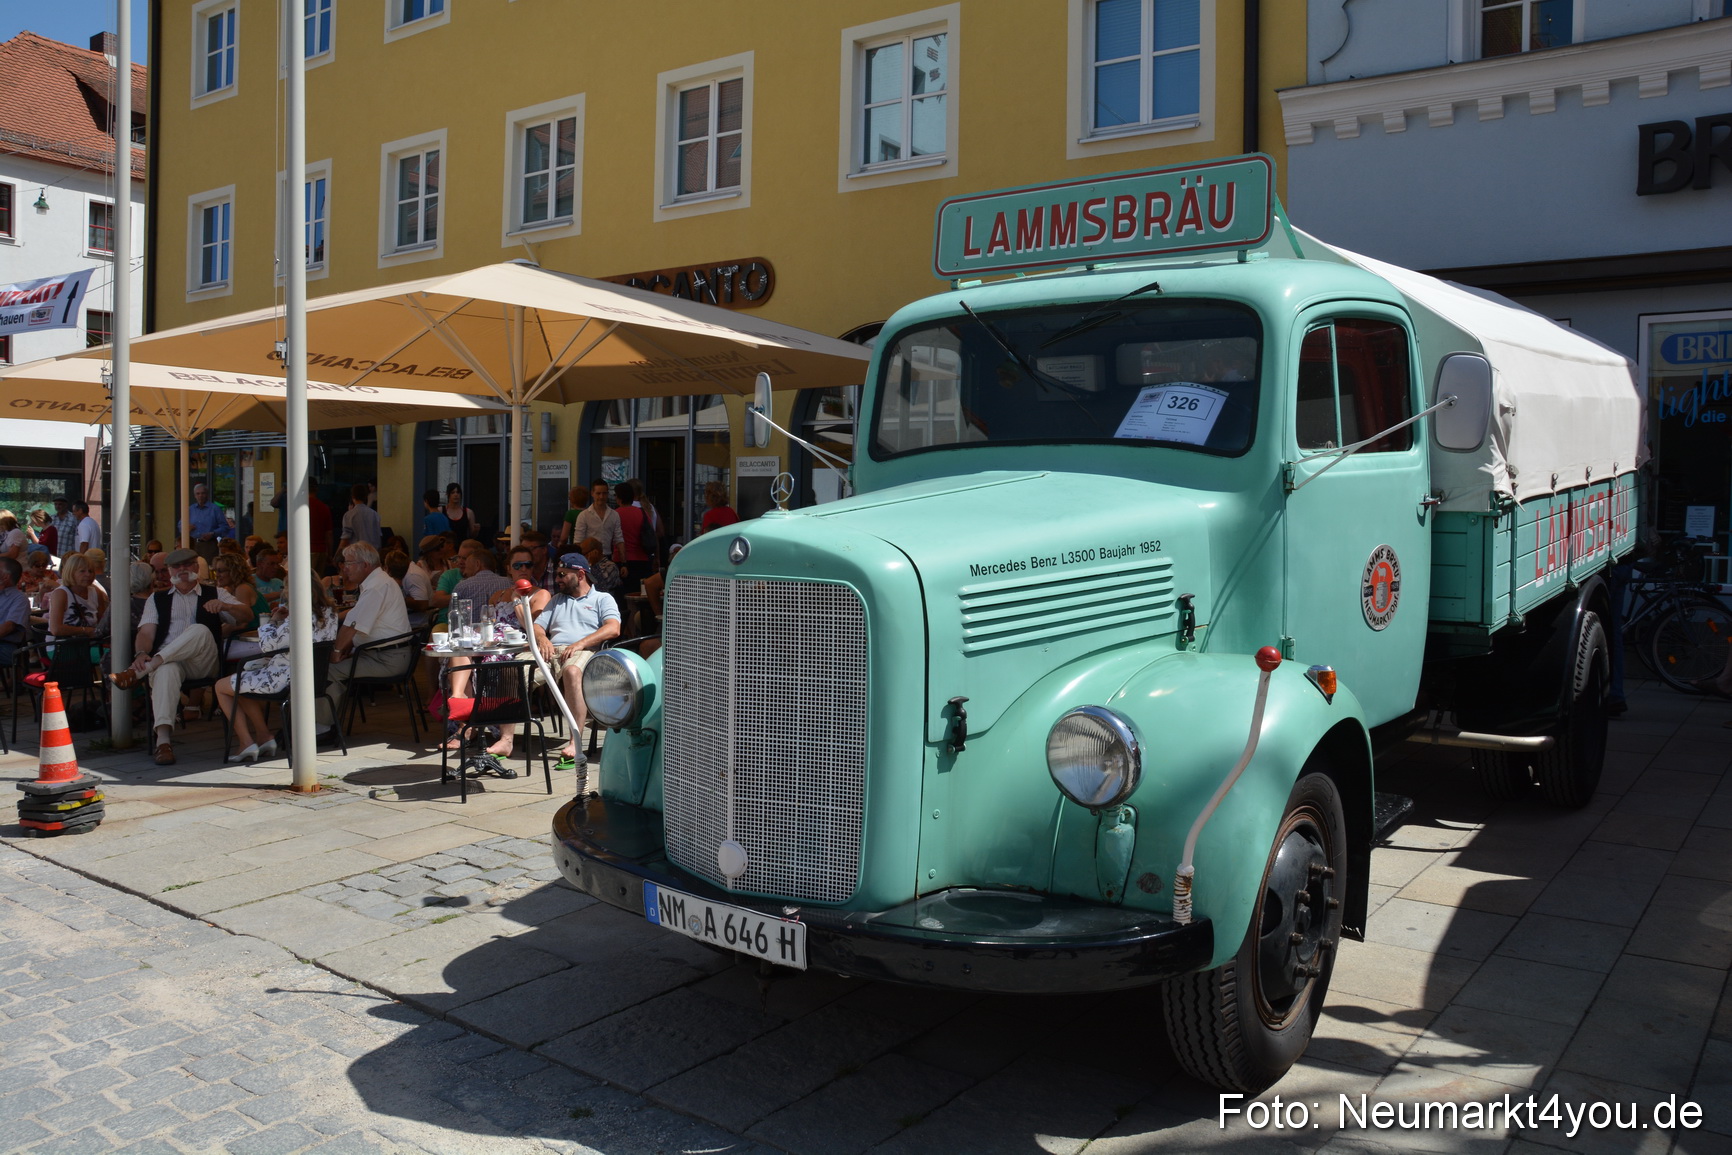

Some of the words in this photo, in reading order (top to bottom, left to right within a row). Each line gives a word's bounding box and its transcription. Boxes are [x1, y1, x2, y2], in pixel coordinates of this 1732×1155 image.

[963, 175, 1236, 260] LAMMSBRÄU
[1167, 395, 1200, 411] 326
[1701, 410, 1727, 423] die
[739, 460, 776, 468] BELACCANTO
[969, 559, 1027, 577] Mercedes
[1030, 556, 1058, 569] Benz
[1061, 549, 1096, 565] L3500
[1099, 545, 1136, 561] Baujahr
[1139, 540, 1161, 554] 1952
[658, 891, 687, 930] NM
[704, 906, 717, 940] A
[723, 913, 769, 954] 646
[780, 926, 796, 962] H
